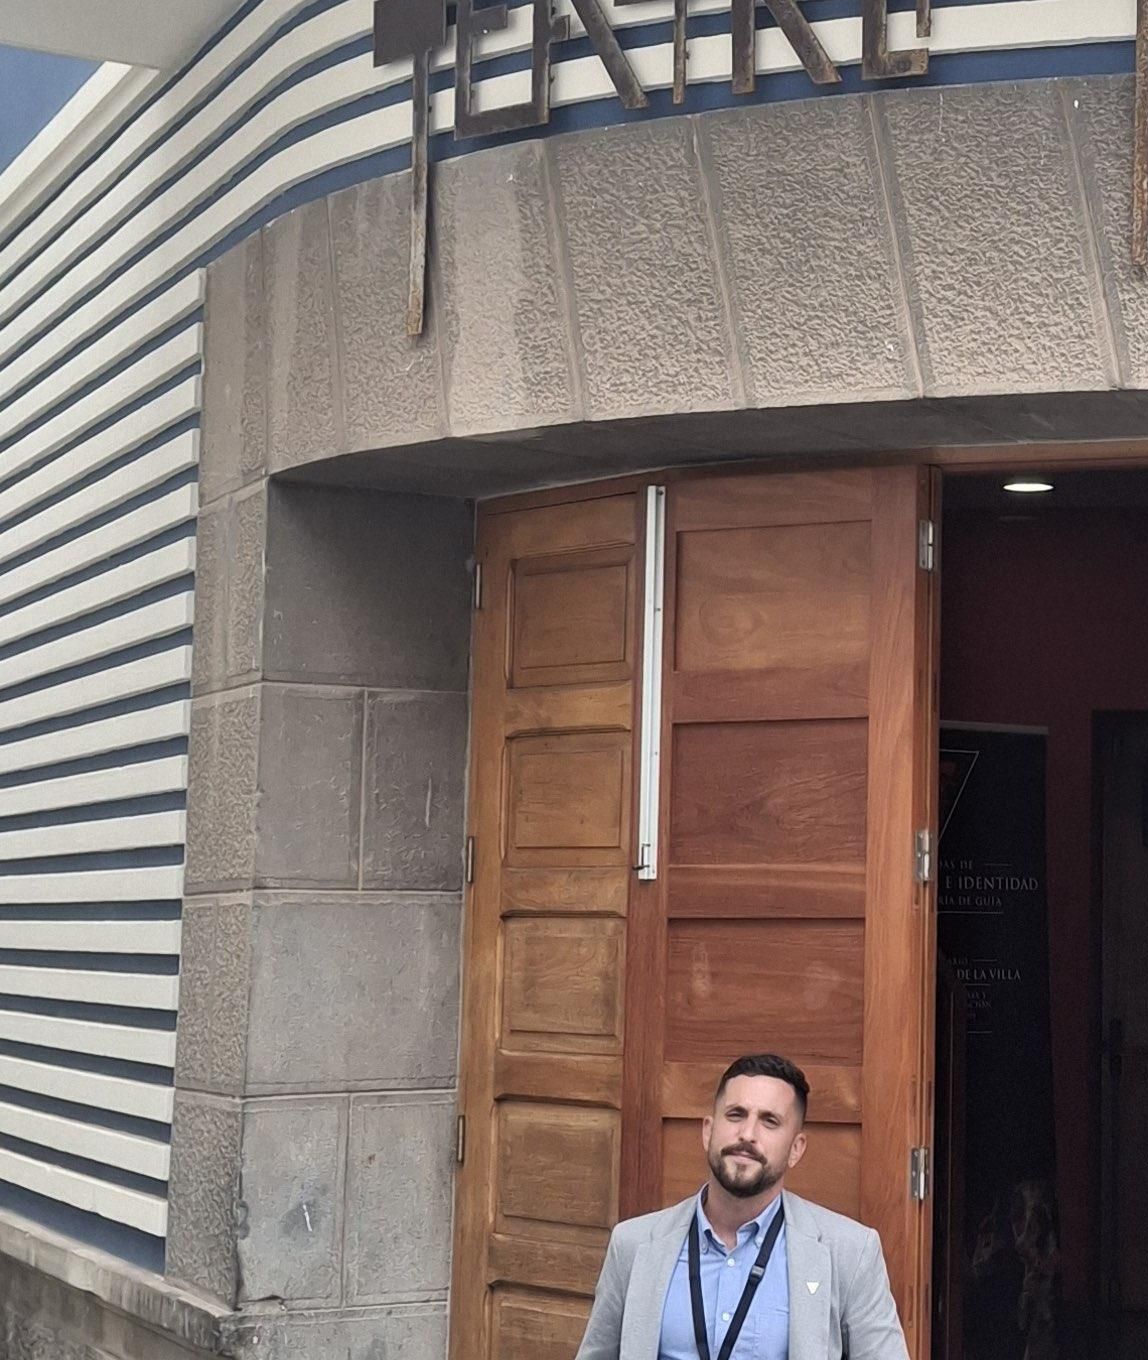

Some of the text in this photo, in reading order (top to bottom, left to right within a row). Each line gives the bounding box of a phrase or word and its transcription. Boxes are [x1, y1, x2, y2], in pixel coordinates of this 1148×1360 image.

[945, 875, 1039, 891] E IDENTIDAD
[958, 895, 971, 906] DE
[973, 968, 988, 981] LA
[989, 968, 1022, 982] VILLA
